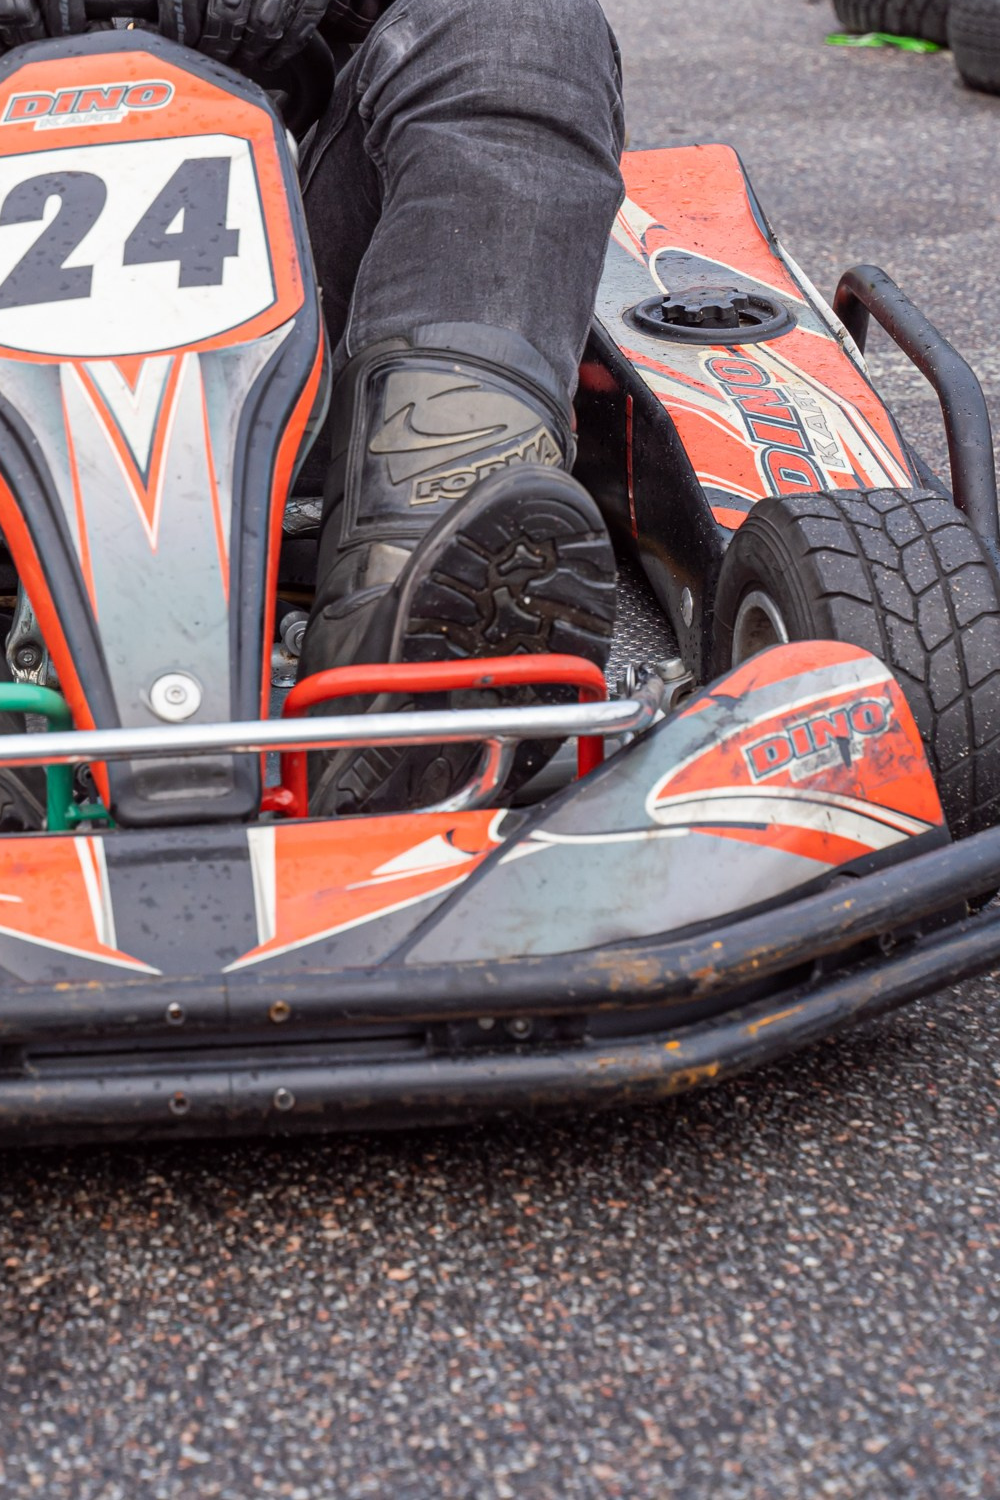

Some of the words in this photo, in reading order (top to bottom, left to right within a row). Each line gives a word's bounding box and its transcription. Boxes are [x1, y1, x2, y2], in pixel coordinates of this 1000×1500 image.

[3, 82, 173, 123] DINO
[39, 110, 124, 128] KART
[708, 356, 829, 497] DINO
[785, 386, 846, 469] KART
[745, 699, 888, 779] DINO
